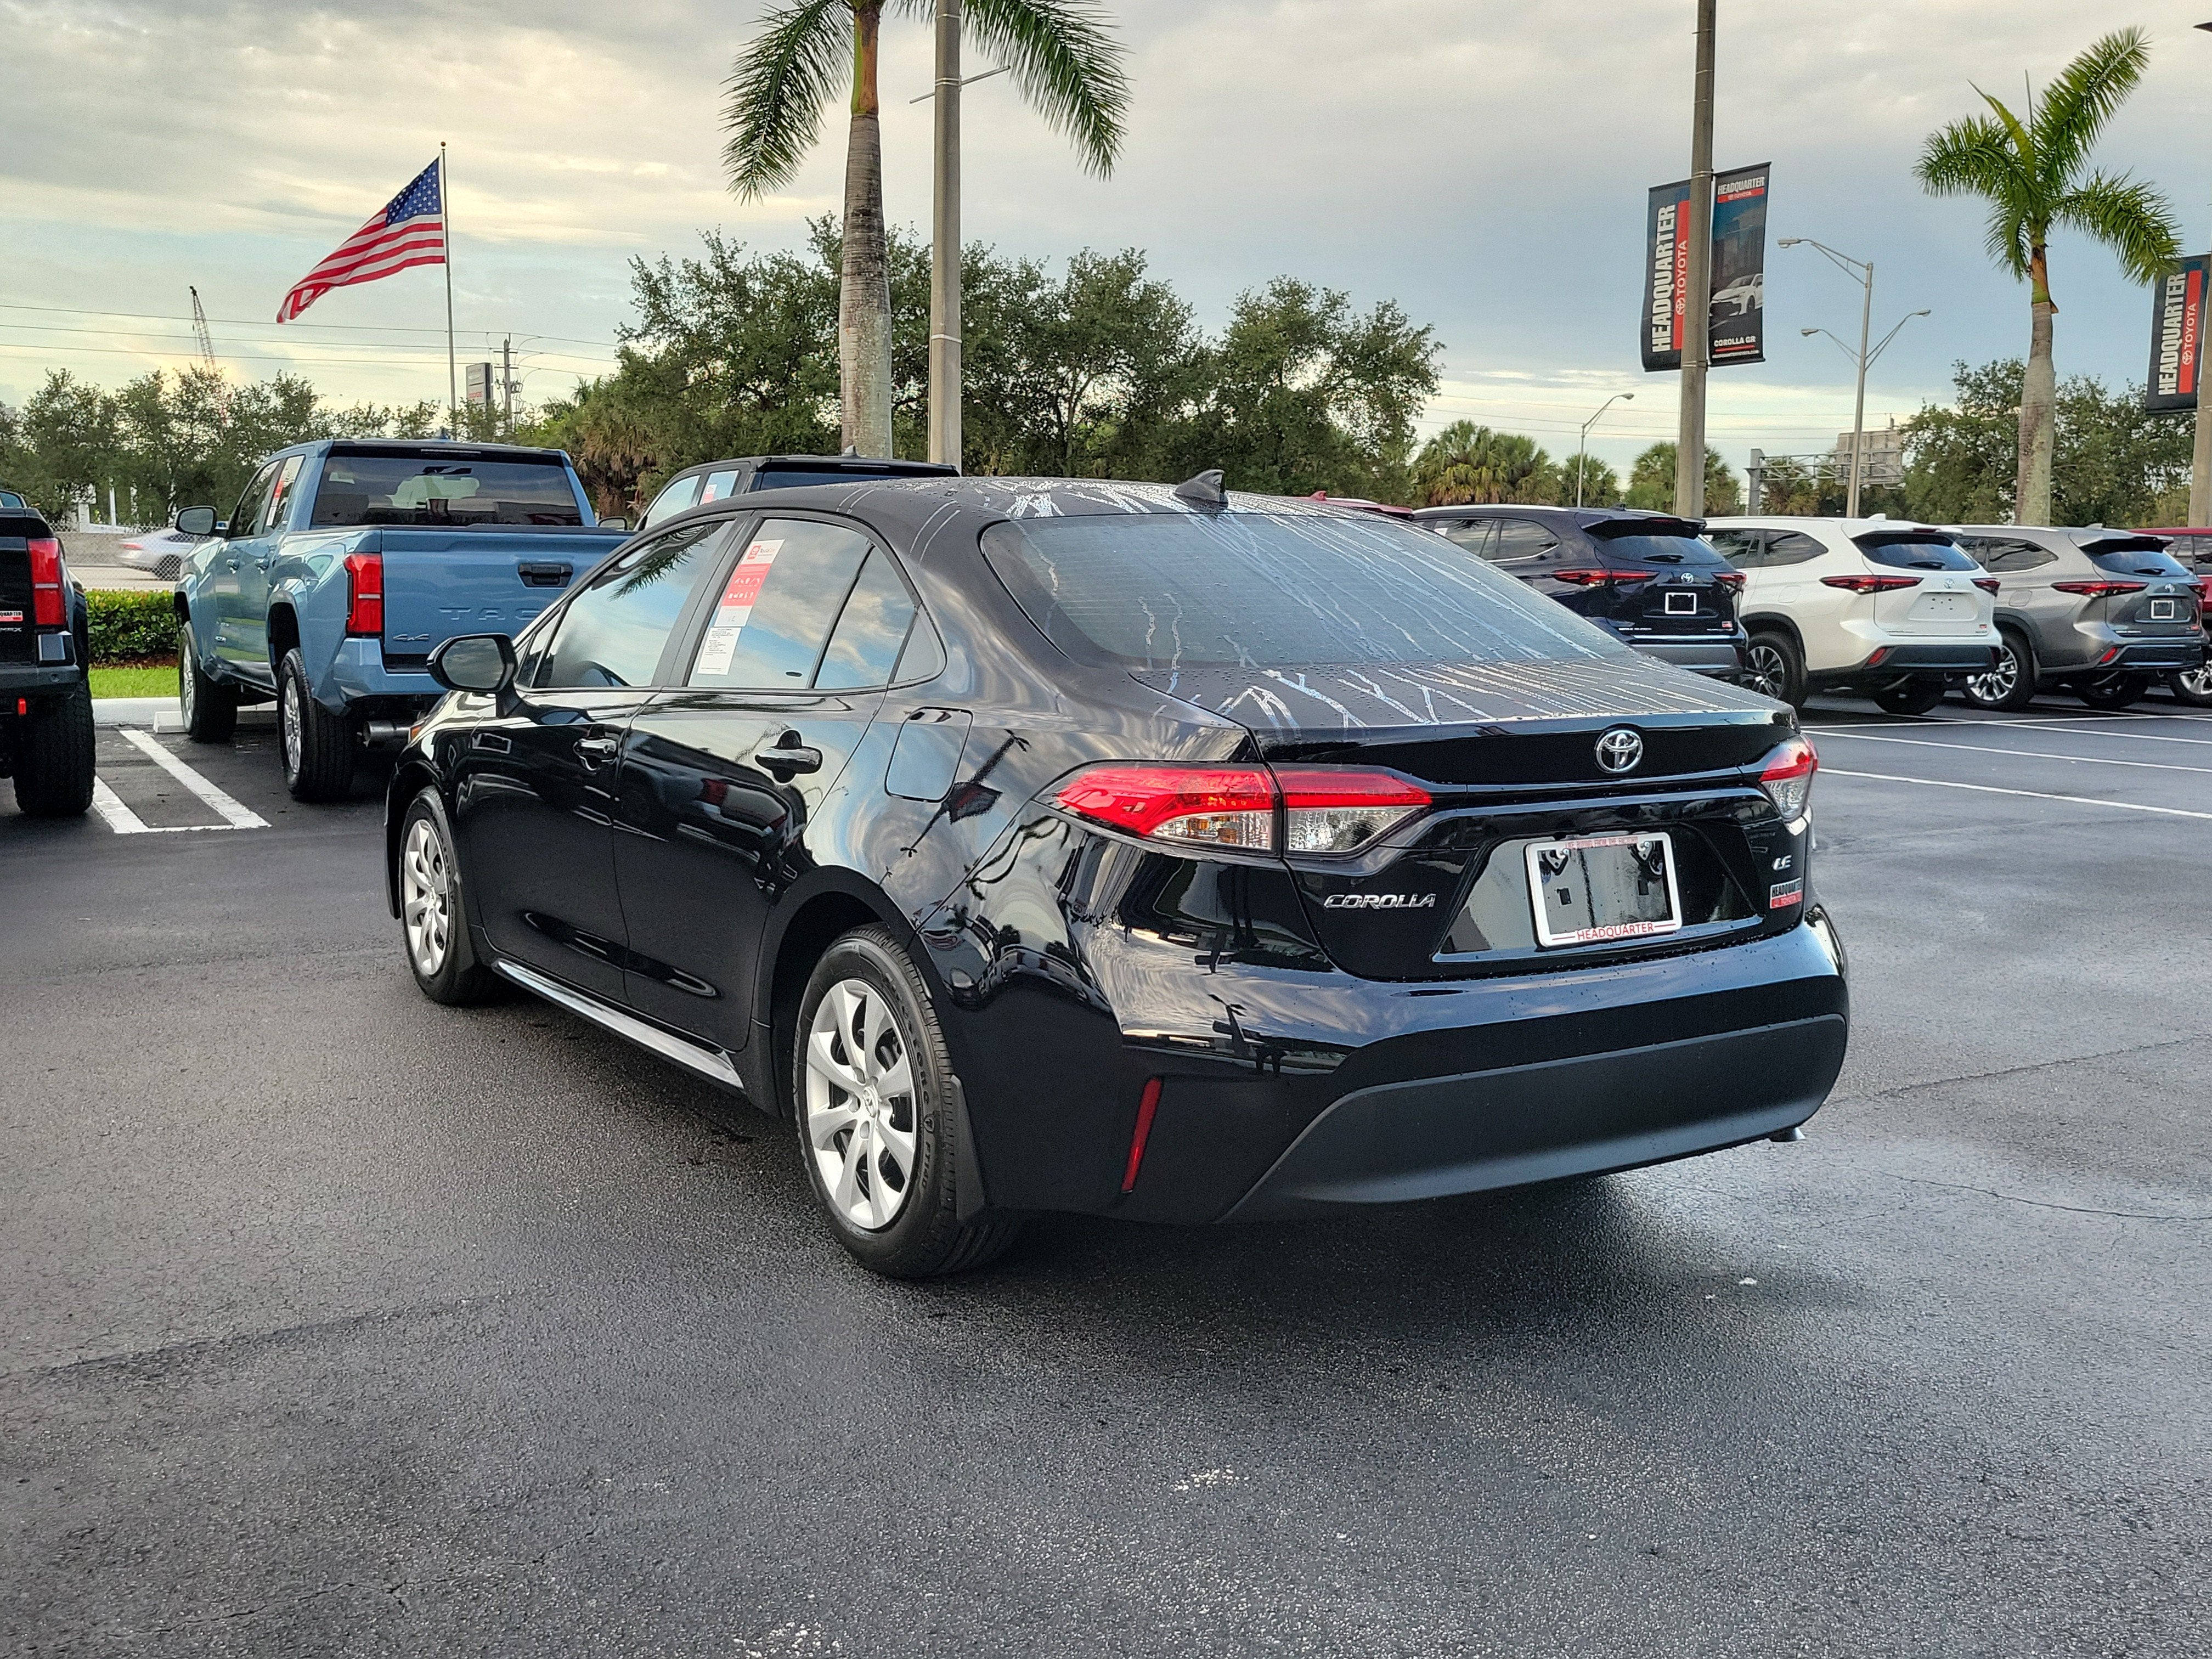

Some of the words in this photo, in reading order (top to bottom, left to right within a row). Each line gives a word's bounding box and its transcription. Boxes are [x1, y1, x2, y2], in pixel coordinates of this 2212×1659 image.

[1718, 177, 1764, 195] HEADQUARTER
[1677, 240, 1688, 297] TOYOTA
[1652, 204, 1675, 352] HEADQUARTER
[2158, 273, 2186, 396] HEADQUARTER
[2184, 303, 2197, 350] TOYOTA
[1714, 337, 1745, 347] COROLLA
[1772, 855, 1792, 871] LE
[1324, 893, 1436, 909] COROLLA
[1577, 923, 1654, 941] HEADQUARTER
